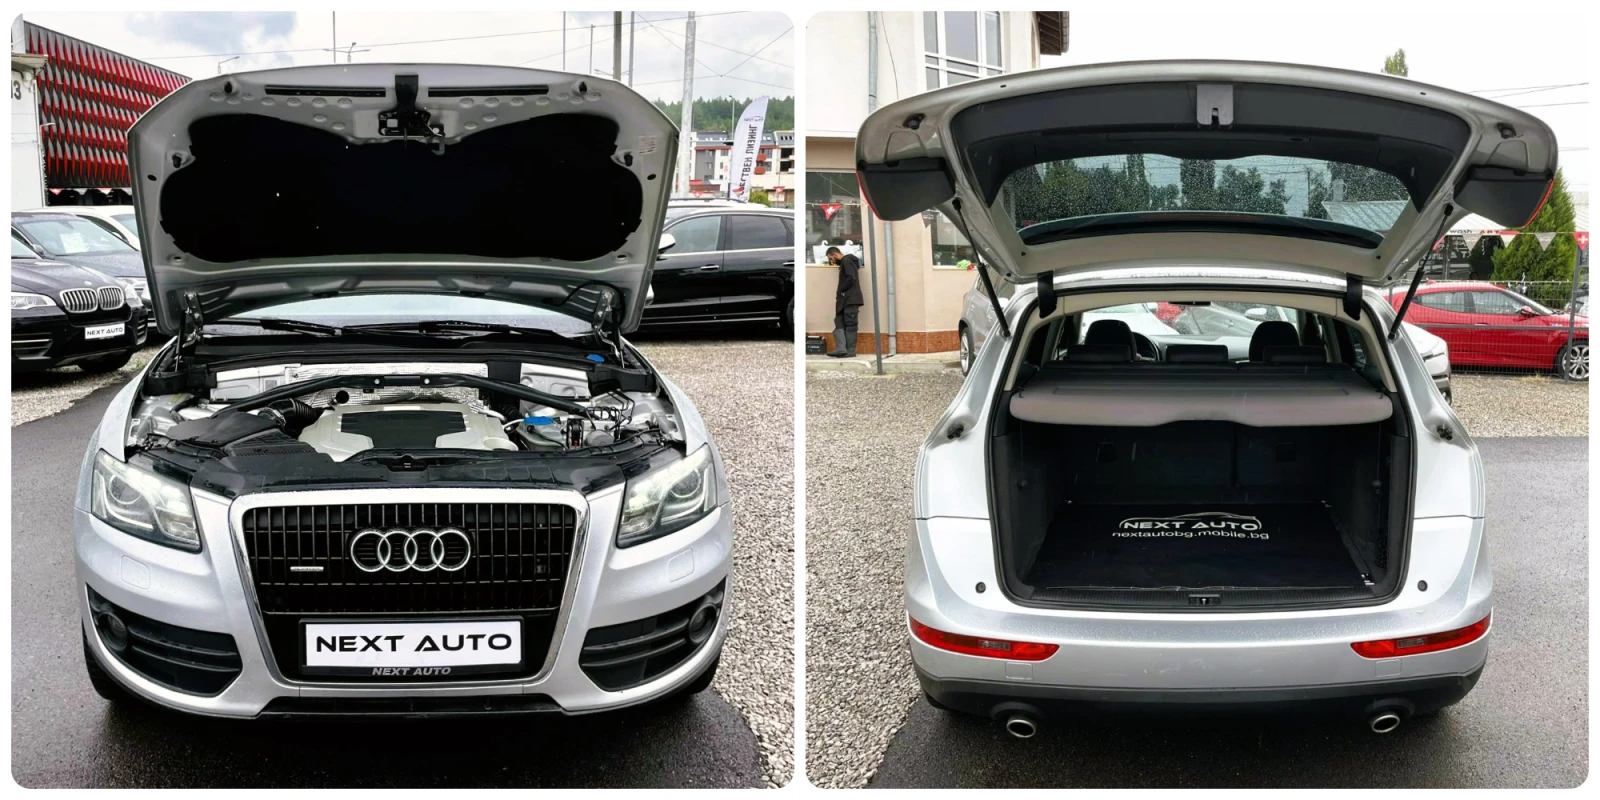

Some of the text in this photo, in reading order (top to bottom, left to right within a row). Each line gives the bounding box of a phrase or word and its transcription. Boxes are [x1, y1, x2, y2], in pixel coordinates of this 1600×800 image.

[745, 124, 757, 154] ЛИЗИНГ
[1123, 521, 1258, 530] NEXT AUTO
[1112, 530, 1269, 539] nextautobg.mobile.bg
[316, 633, 512, 652] NEXT AUTO
[372, 666, 451, 676] NEXT AUTO
